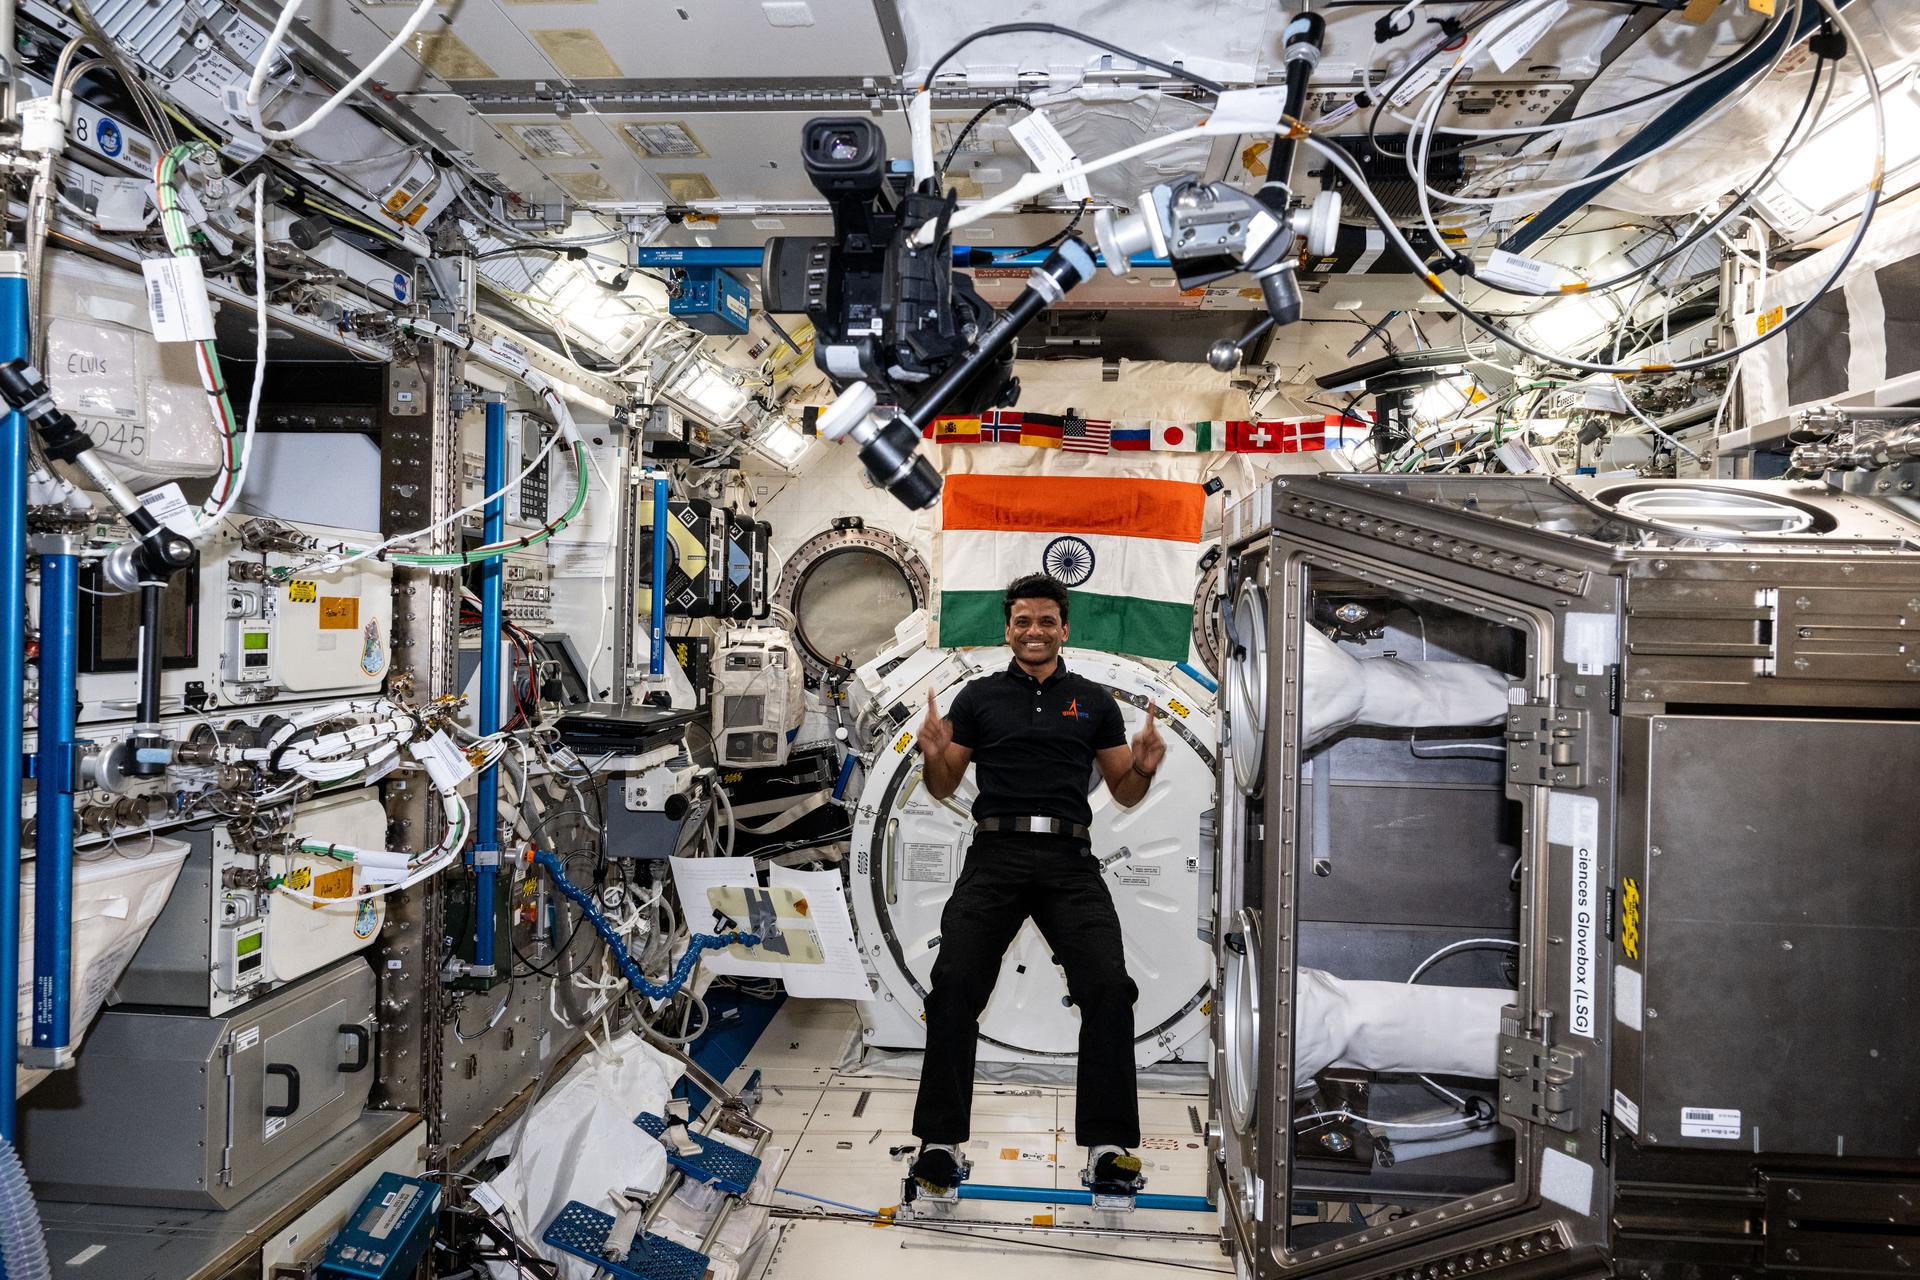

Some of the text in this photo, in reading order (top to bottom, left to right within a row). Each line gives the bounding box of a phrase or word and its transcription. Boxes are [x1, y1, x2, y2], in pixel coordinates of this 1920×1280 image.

[76, 117, 88, 141] 8
[67, 353, 107, 373] ELVIS
[1575, 912, 1591, 984] Glovebox
[1573, 988, 1590, 1034] (LSG)
